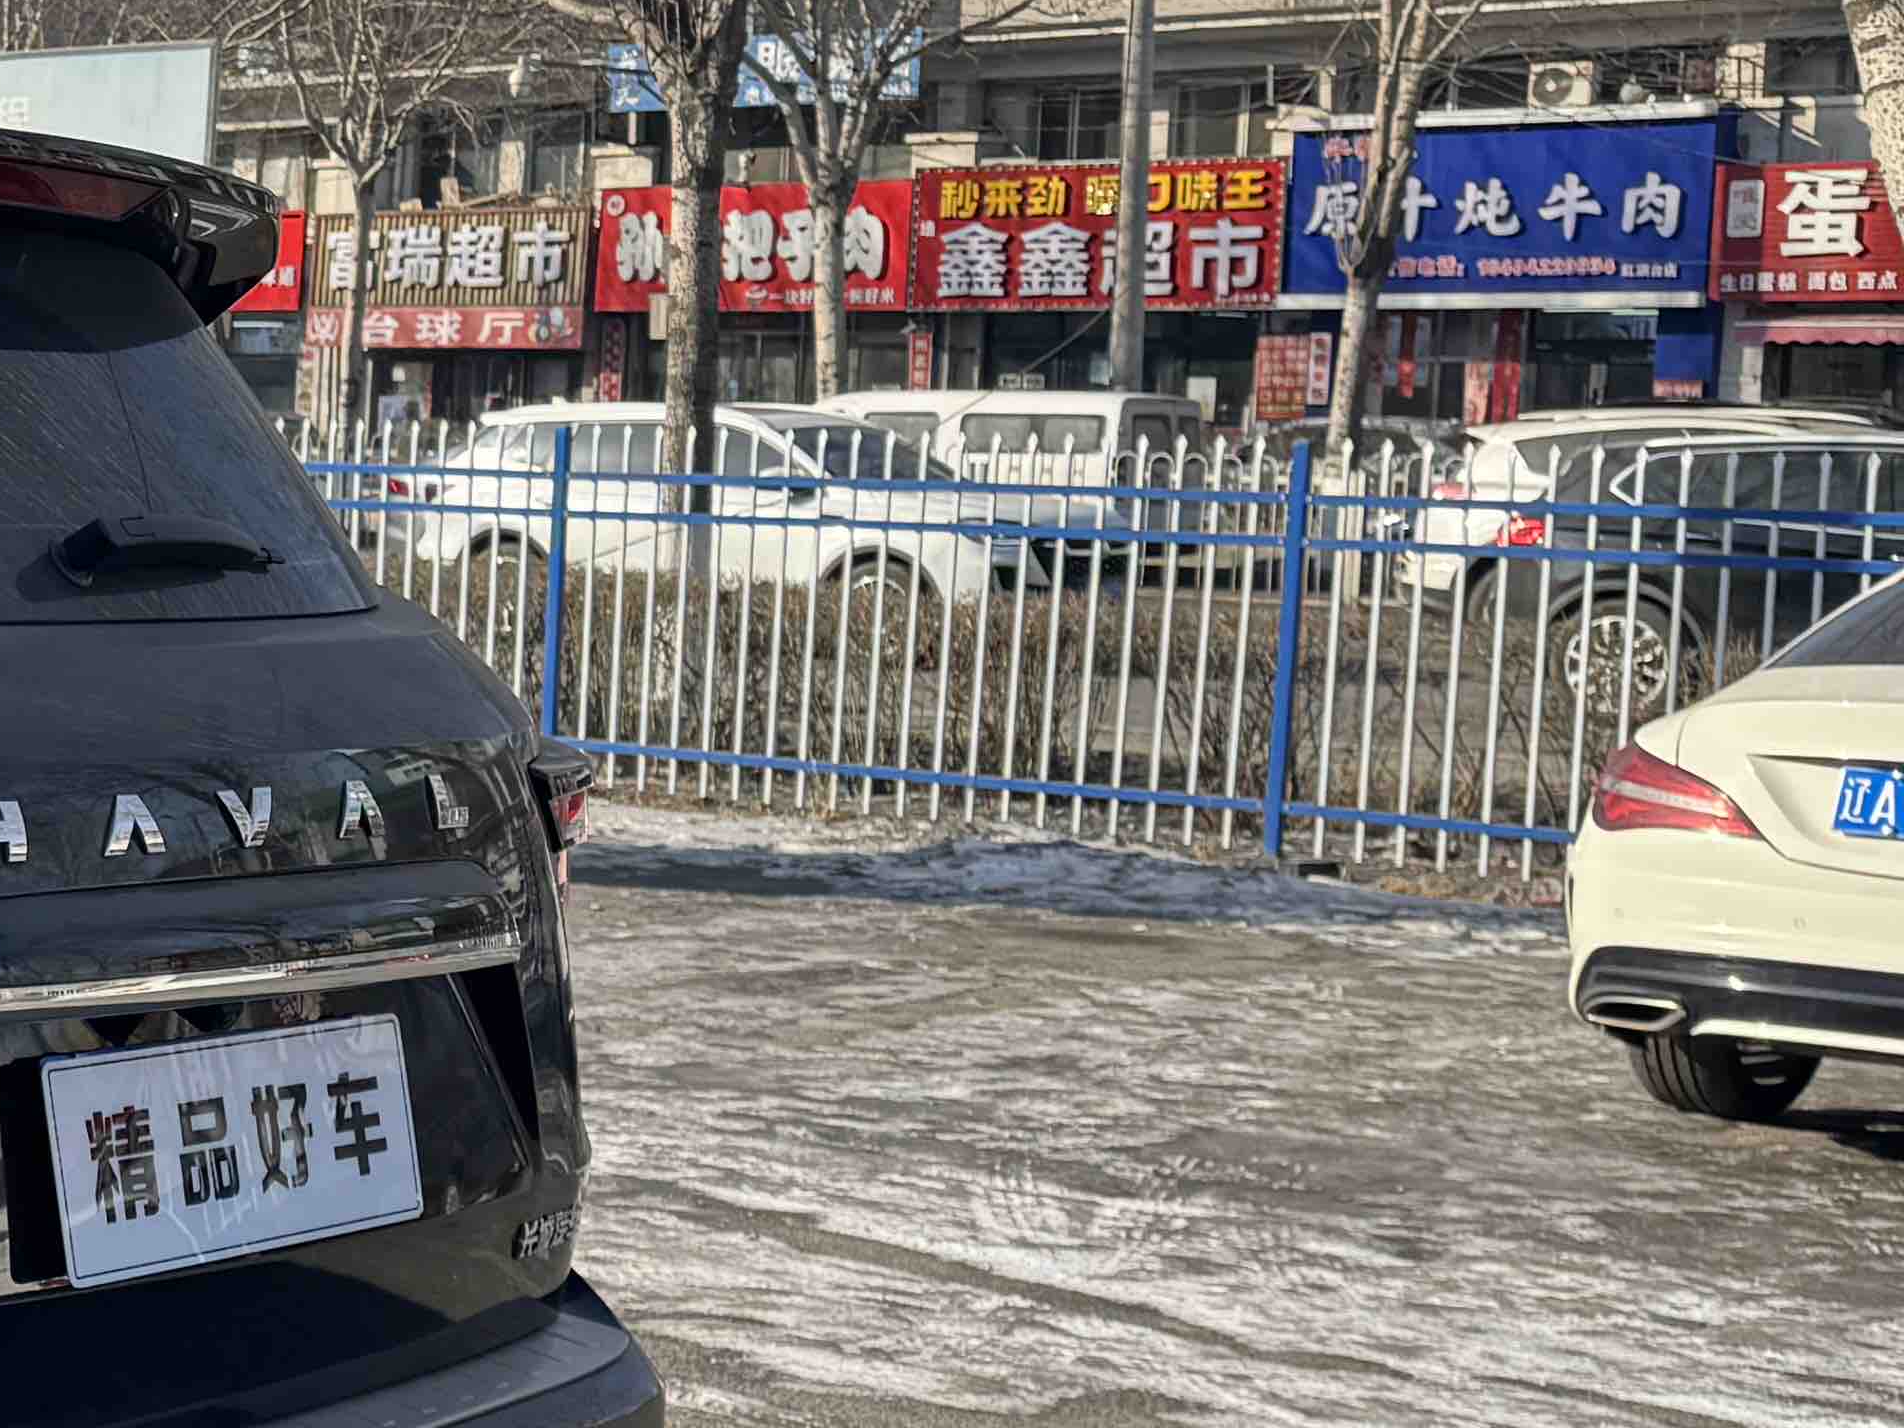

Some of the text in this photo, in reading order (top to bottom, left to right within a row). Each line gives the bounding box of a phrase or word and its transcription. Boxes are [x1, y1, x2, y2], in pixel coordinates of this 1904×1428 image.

[940, 175, 1067, 219] 秒来劲
[1303, 172, 1681, 242] 原汁炖牛肉
[326, 221, 570, 289] 富瑞超市
[937, 218, 1264, 299] 鑫鑫超市
[362, 311, 526, 345] 台球厅
[85, 1071, 388, 1224] 精品好车
